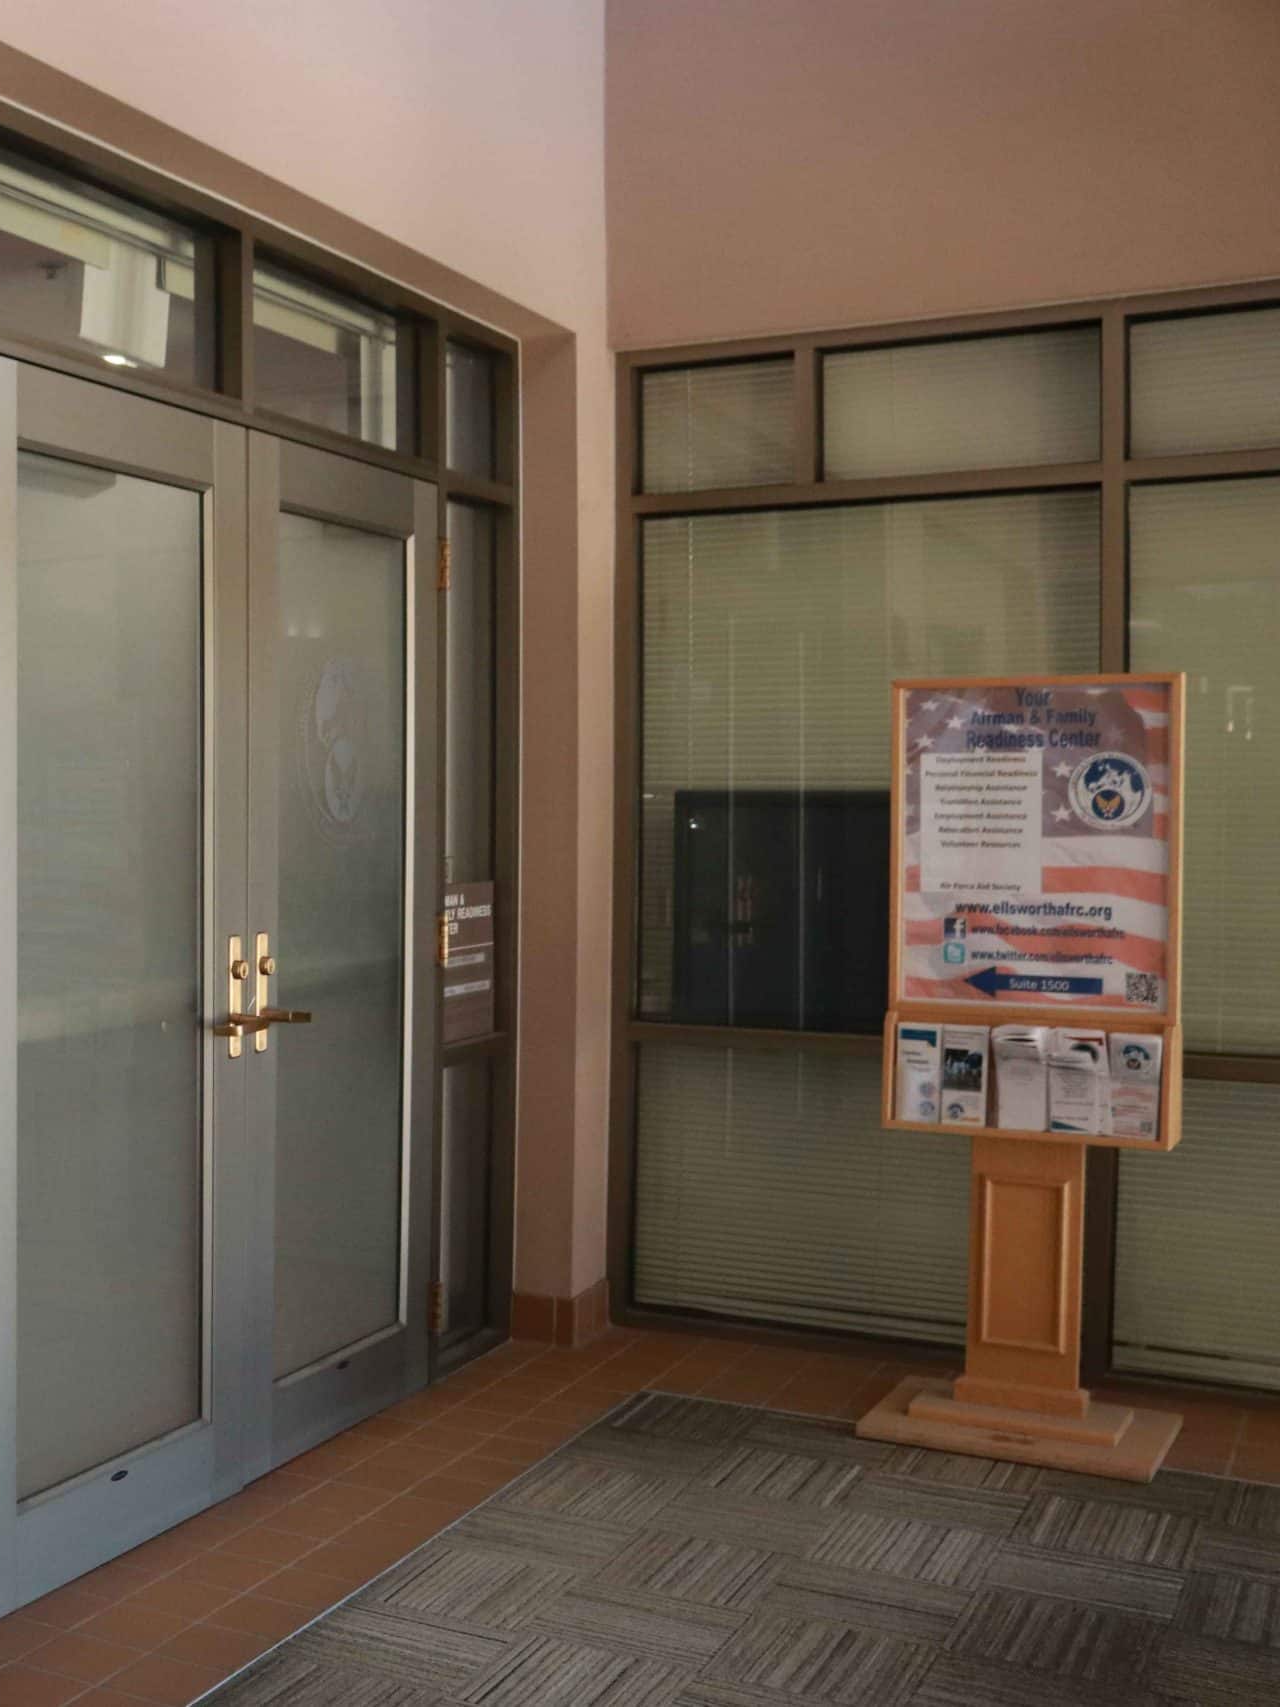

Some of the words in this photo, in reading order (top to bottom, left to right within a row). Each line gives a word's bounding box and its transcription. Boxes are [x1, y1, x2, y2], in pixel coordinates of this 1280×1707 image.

[1015, 687, 1051, 706] Your
[971, 711, 1025, 724] Airman
[1029, 709, 1041, 724] &
[1046, 708, 1097, 727] Family
[966, 729, 1044, 749] Readiness
[1048, 728, 1102, 747] Center
[954, 902, 1113, 921] www.ellsworthafrc.org
[1008, 978, 1038, 991] Suite
[1041, 980, 1071, 992] 1500
